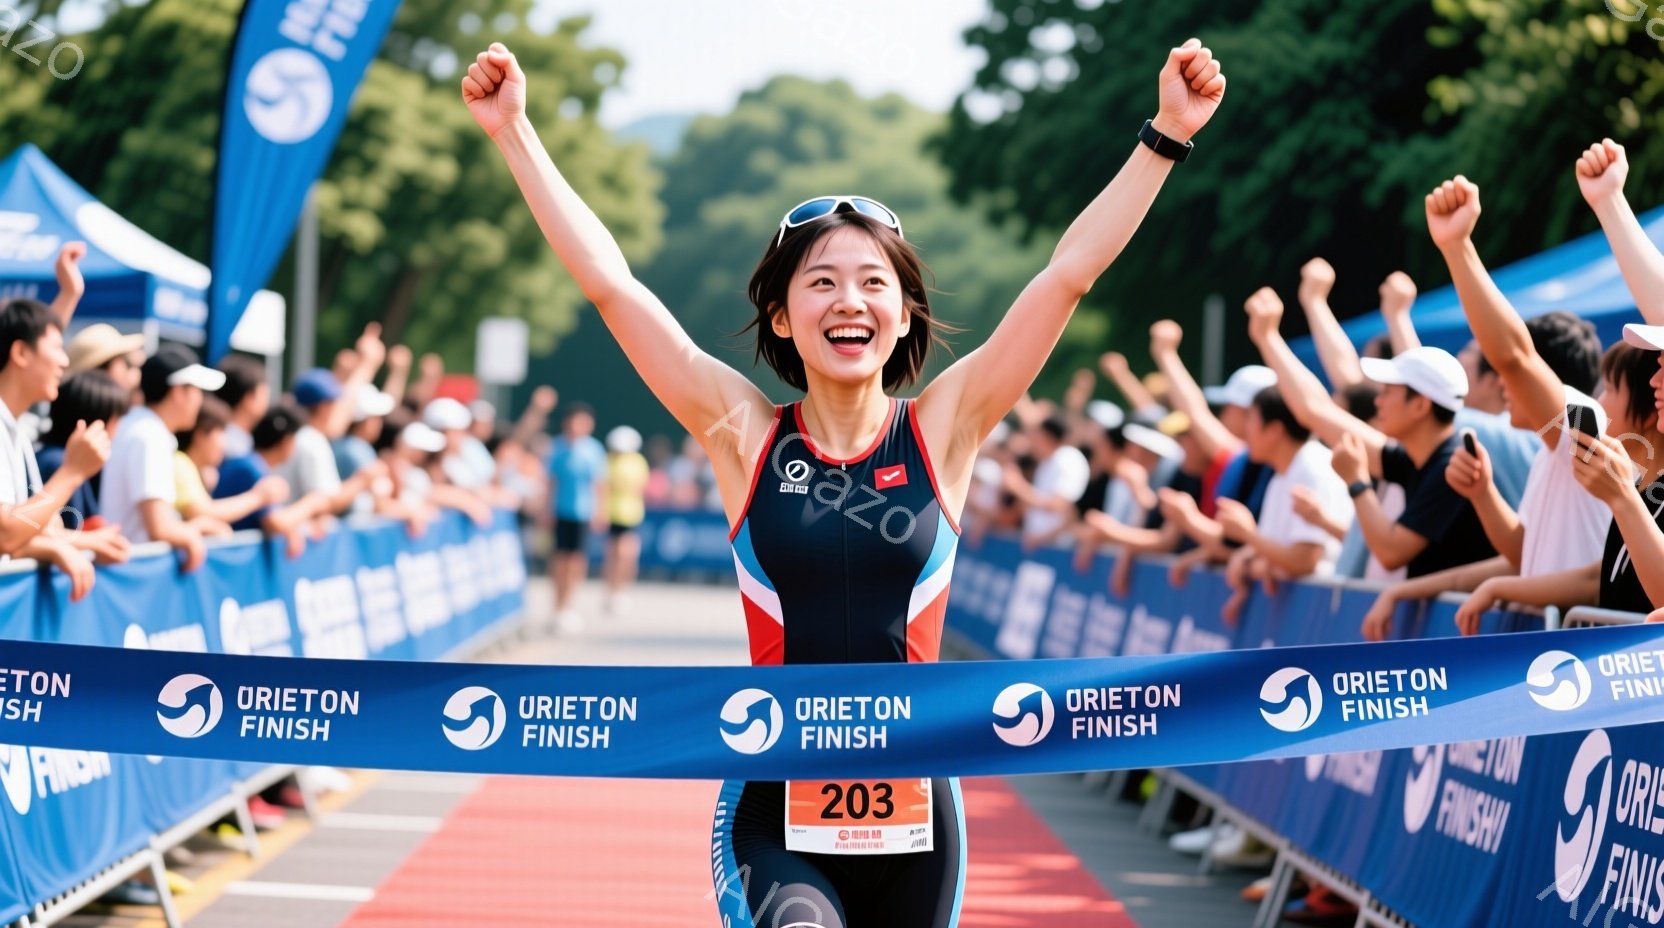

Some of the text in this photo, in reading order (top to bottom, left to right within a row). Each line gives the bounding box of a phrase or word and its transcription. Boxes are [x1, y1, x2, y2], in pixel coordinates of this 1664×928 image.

[1610, 676, 1664, 700] FINI
[1341, 696, 1429, 721] FINISH
[240, 715, 330, 741] FINISH
[522, 724, 610, 748] FINISH
[801, 725, 887, 749] FINISH
[1072, 713, 1157, 739] FINISH
[821, 782, 894, 820] 203
